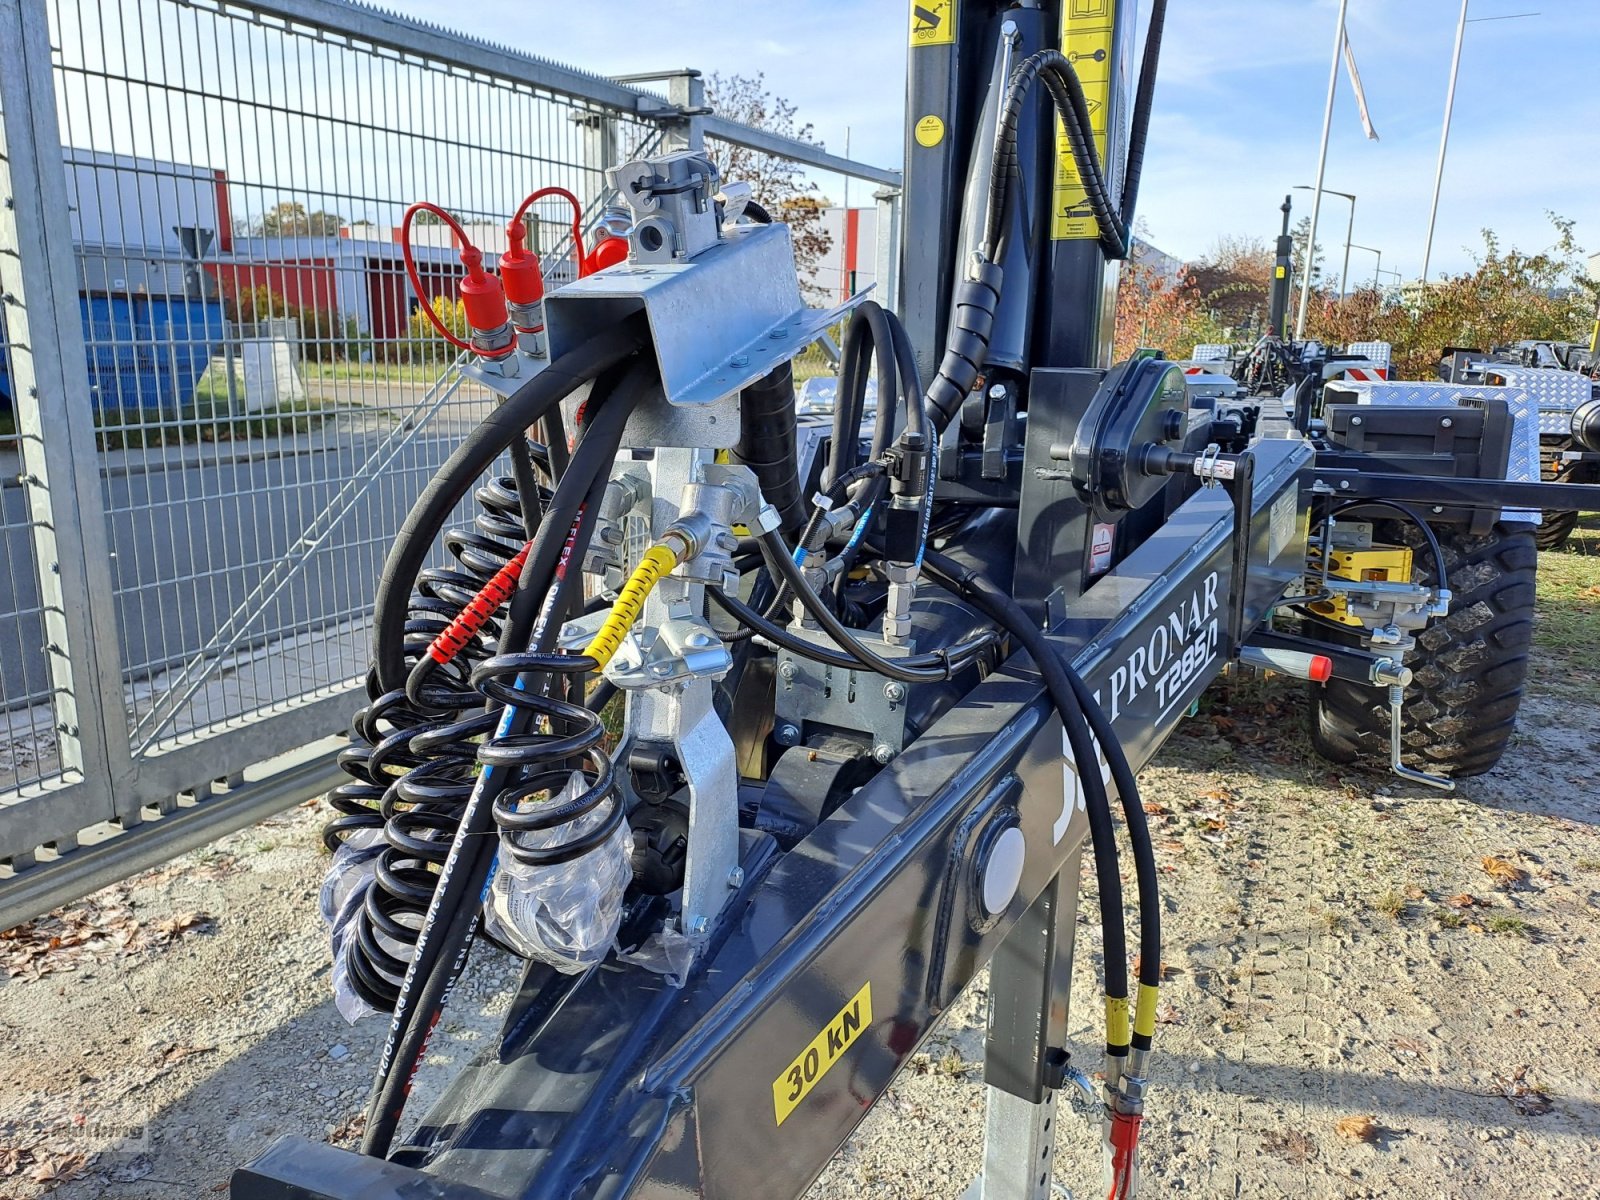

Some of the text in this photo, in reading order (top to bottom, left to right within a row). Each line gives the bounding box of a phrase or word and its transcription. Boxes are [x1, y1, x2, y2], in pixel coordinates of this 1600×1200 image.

[533, 617, 549, 639] EN
[1109, 571, 1218, 724] PRONAR
[468, 783, 485, 817] SAE
[454, 822, 470, 849] 100
[439, 854, 459, 897] R2AT
[414, 935, 428, 962] WP
[402, 963, 417, 993] 330
[440, 975, 456, 1004] DIN
[390, 998, 407, 1032] BAR
[787, 1000, 860, 1101] 30 kN
